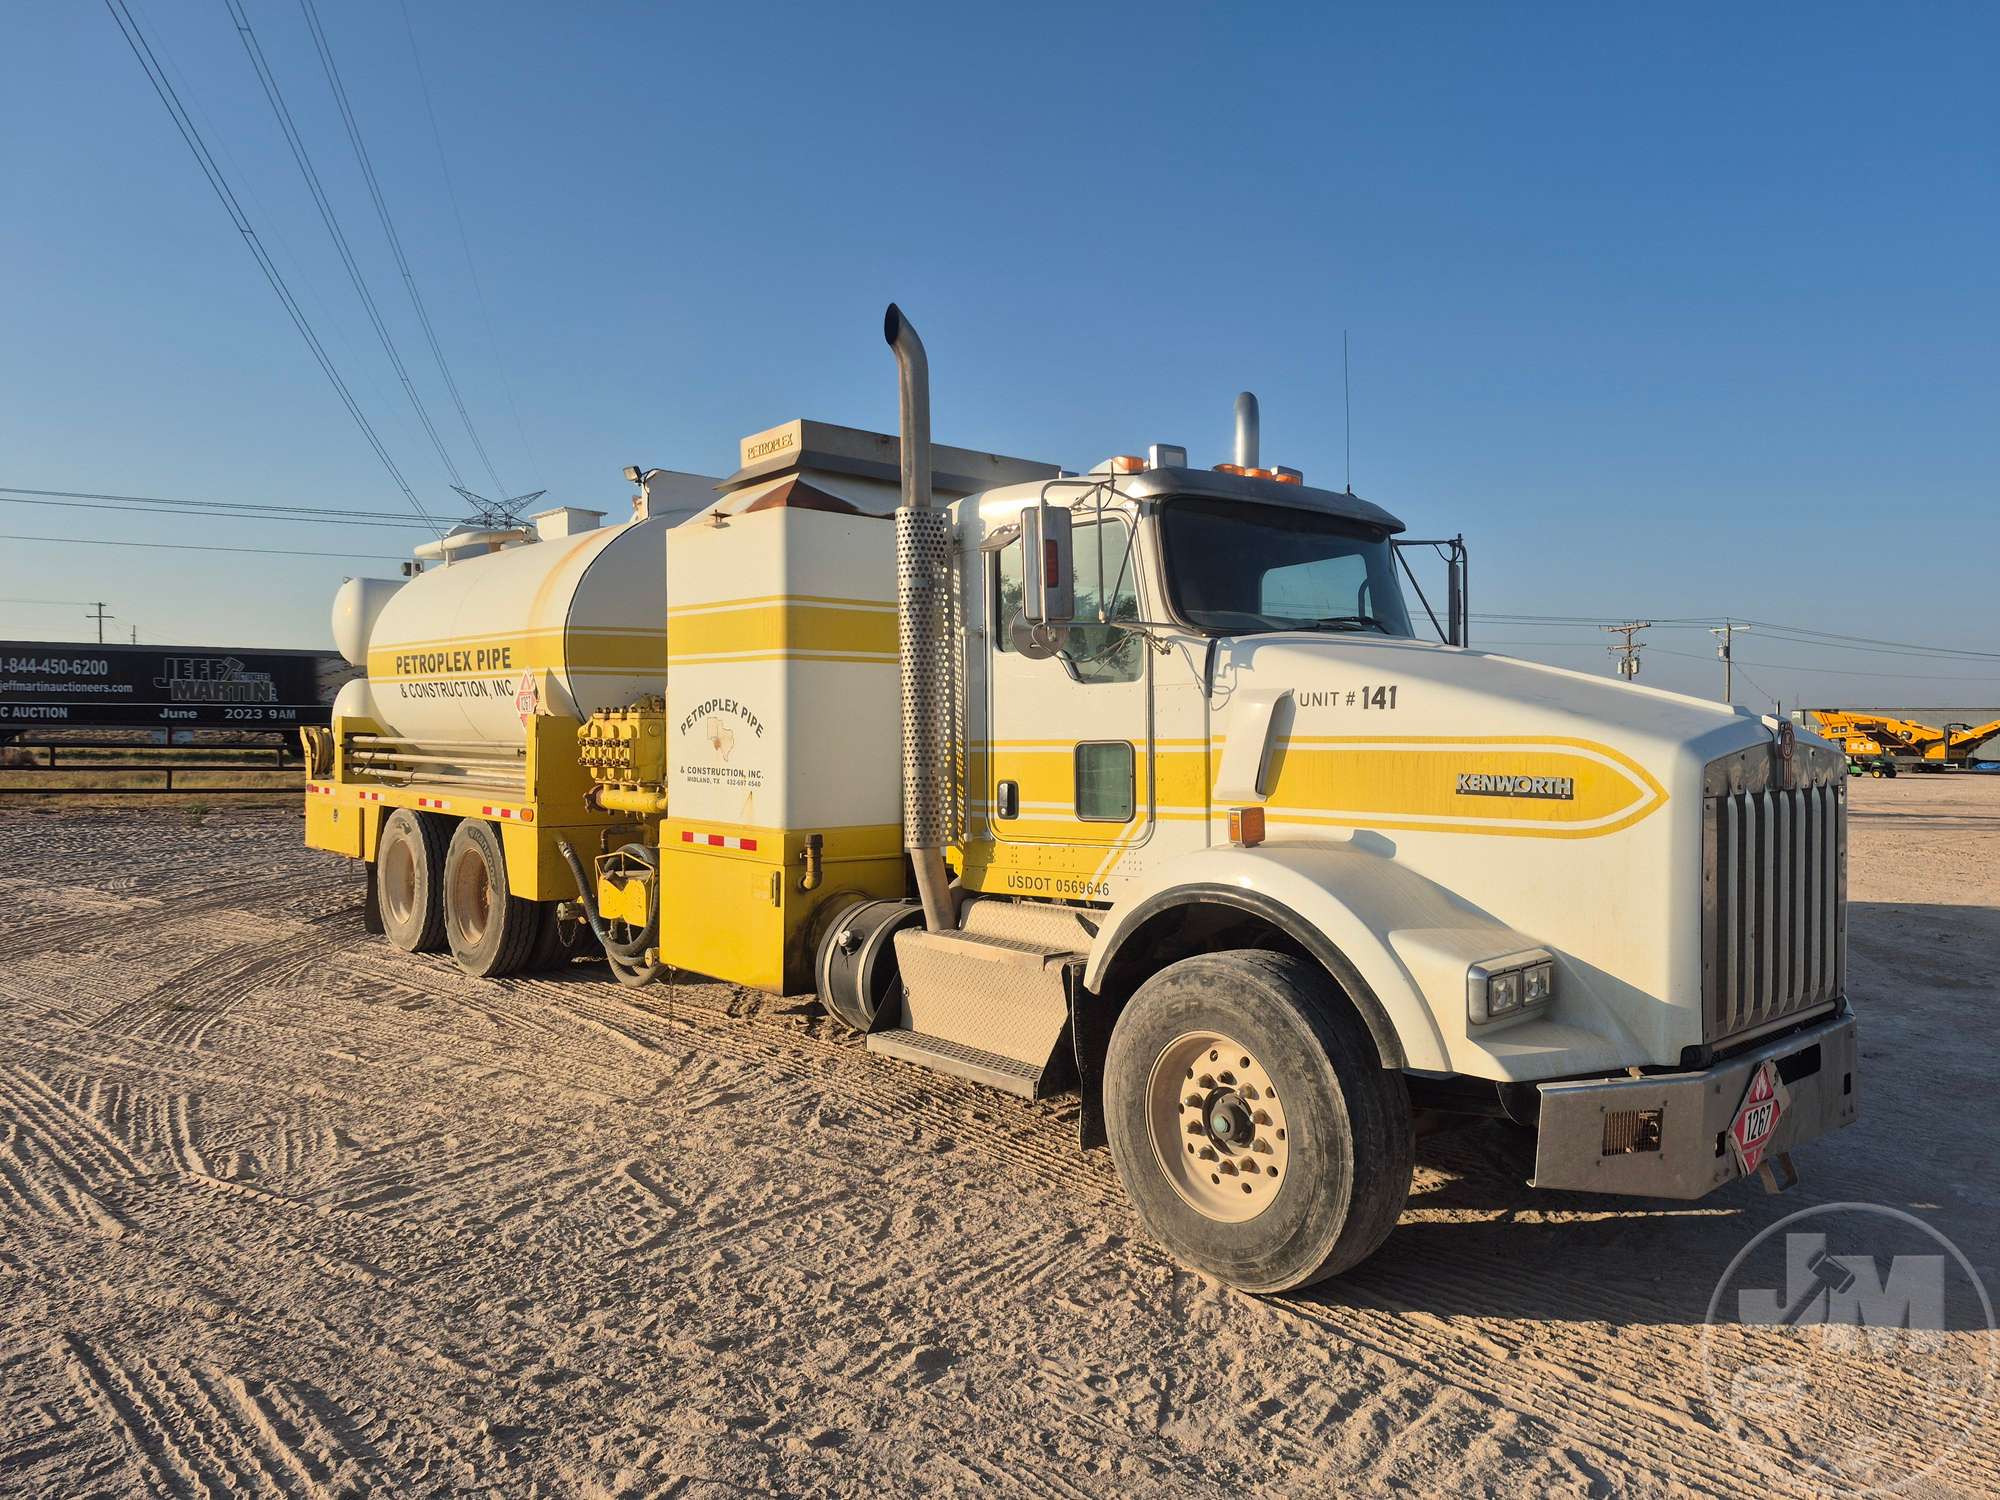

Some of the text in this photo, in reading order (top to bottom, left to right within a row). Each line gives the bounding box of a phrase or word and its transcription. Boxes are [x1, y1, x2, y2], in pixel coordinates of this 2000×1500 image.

[747, 433, 793, 459] PETROPLEX
[396, 647, 512, 674] PETROPLEX PIPE
[170, 679, 273, 702] MARTIN
[400, 683, 408, 698] &
[494, 679, 514, 697] INC
[1300, 685, 1397, 710] UNIT # 141
[12, 706, 68, 719] AUCTION
[159, 708, 198, 719] June
[224, 708, 263, 720] 2023
[680, 698, 764, 738] PETROPLEX PIPE
[1456, 773, 1574, 797] KENWORTH
[1007, 875, 1110, 896] USDOT 0569646
[1747, 1104, 1771, 1141] 1267
